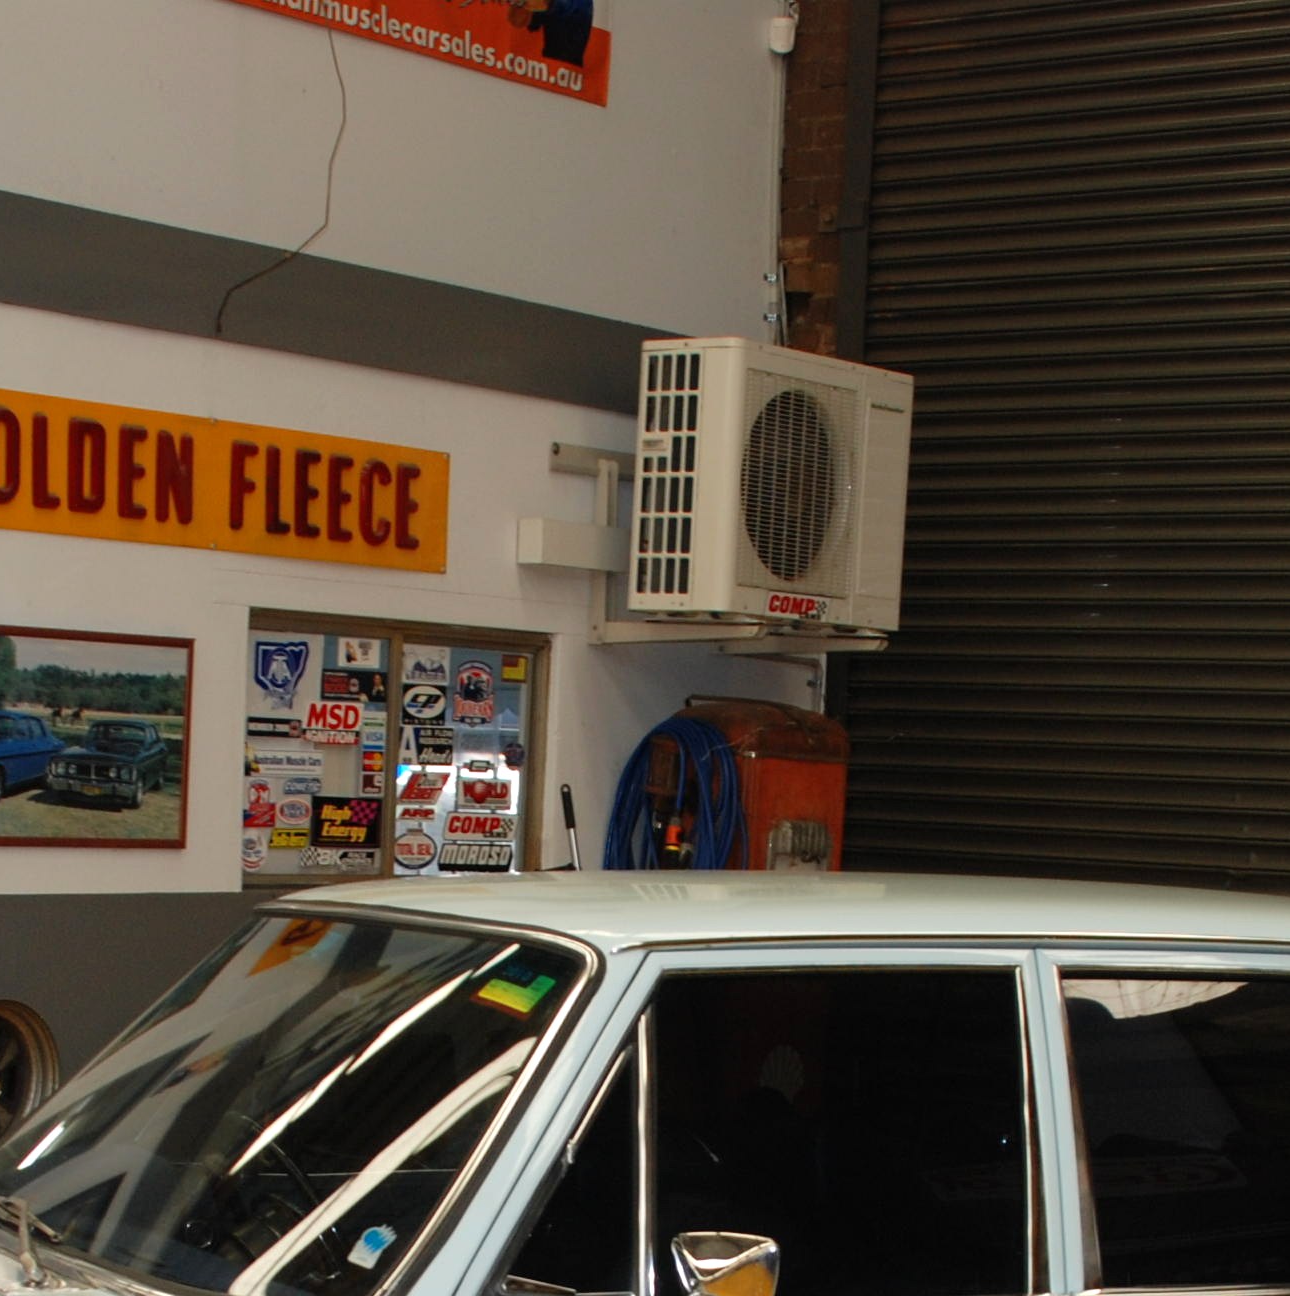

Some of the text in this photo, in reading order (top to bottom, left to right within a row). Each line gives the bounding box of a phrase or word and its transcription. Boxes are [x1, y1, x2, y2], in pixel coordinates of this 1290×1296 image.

[265, 0, 582, 91] anmusclecarsales.com.au
[228, 439, 421, 550] FLEECE
[769, 594, 816, 614] COMP
[307, 703, 360, 729] MSD
[306, 729, 357, 743] IGNITION
[463, 779, 508, 802] WORLD
[321, 804, 352, 825] High
[401, 808, 435, 818] ARP
[321, 821, 367, 843] Energy
[448, 815, 501, 834] COMP
[440, 844, 511, 866] MOROSO
